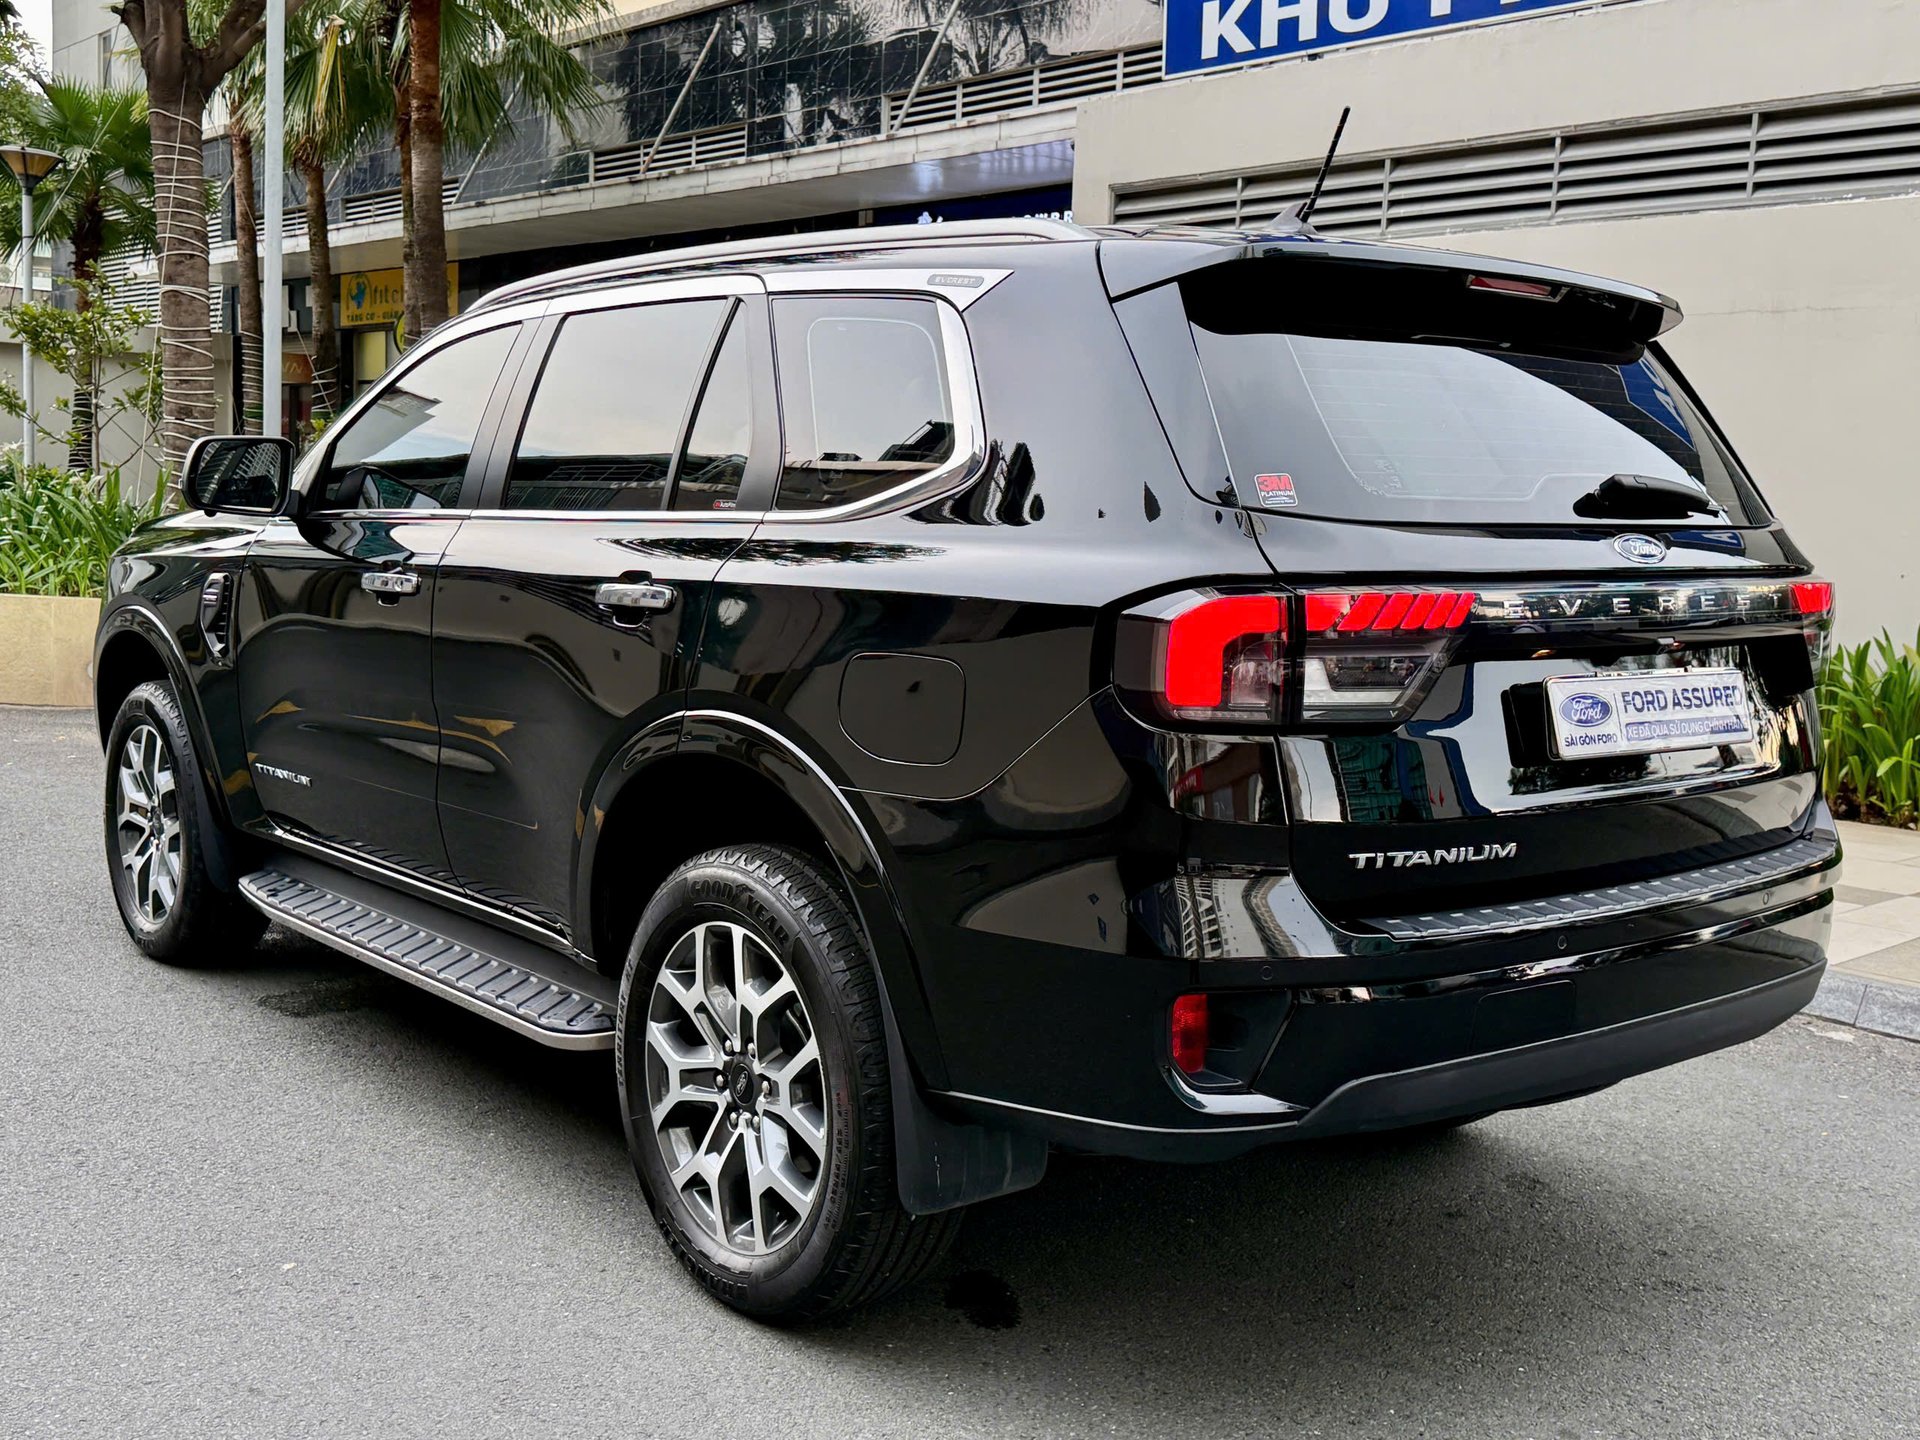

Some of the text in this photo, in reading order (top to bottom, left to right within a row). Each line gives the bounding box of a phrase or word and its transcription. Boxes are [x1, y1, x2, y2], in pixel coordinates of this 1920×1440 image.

[1258, 475, 1293, 491] 3M
[1502, 593, 1783, 619] EVEREST
[1621, 685, 1743, 714] FORD ASSURED
[1565, 732, 1618, 748] SÀI GÒN FORD
[1627, 726, 1639, 738] XE
[1651, 721, 1669, 739] QUA
[254, 762, 312, 788] TITANIUM
[1348, 842, 1517, 869] TITANIUM
